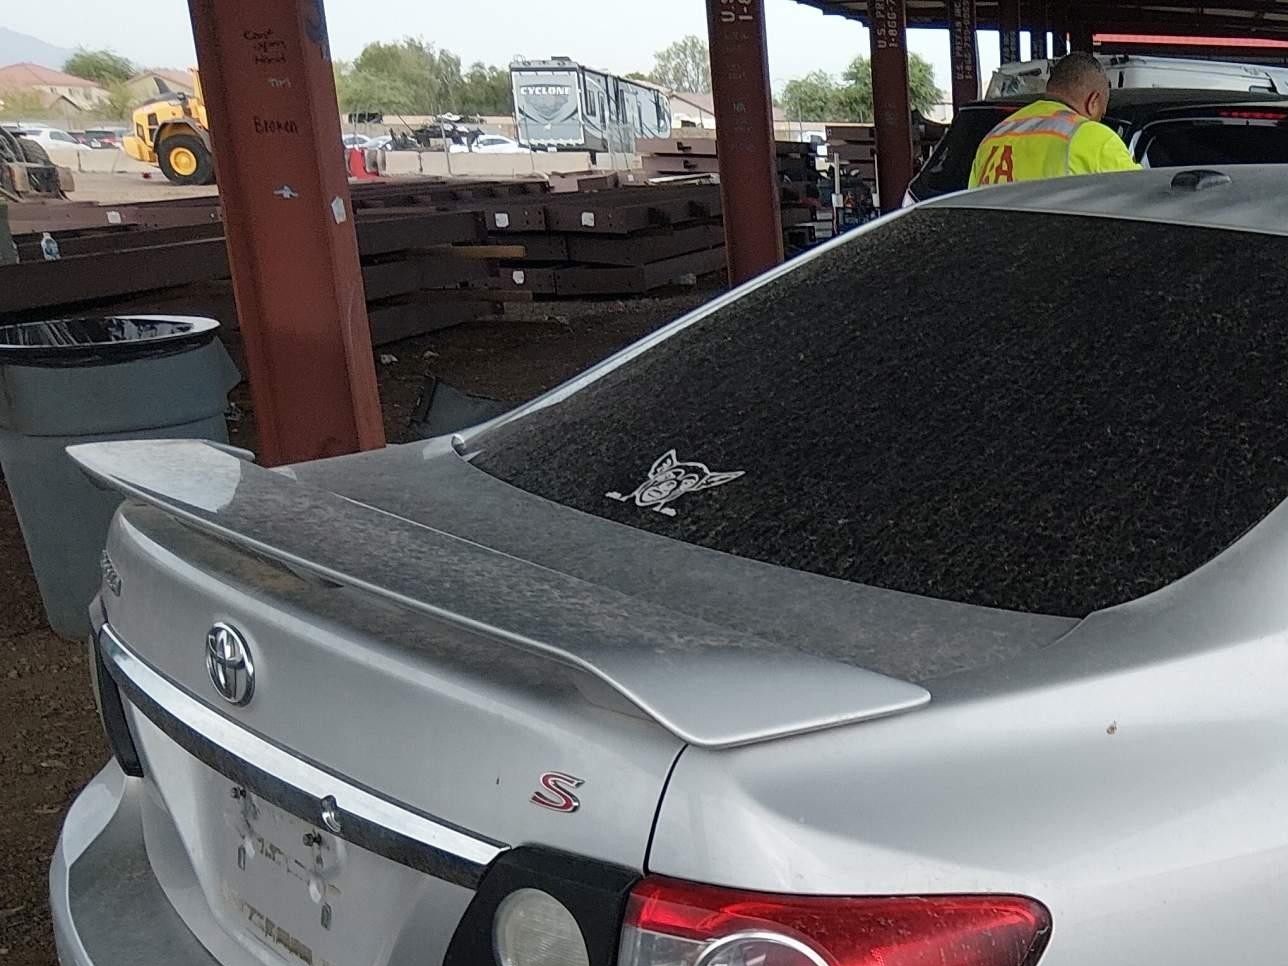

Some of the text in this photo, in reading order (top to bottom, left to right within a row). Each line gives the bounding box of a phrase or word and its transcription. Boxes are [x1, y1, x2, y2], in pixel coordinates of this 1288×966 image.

[875, 0, 886, 18] PR
[520, 87, 571, 95] CYCLONE
[529, 771, 586, 813] S
